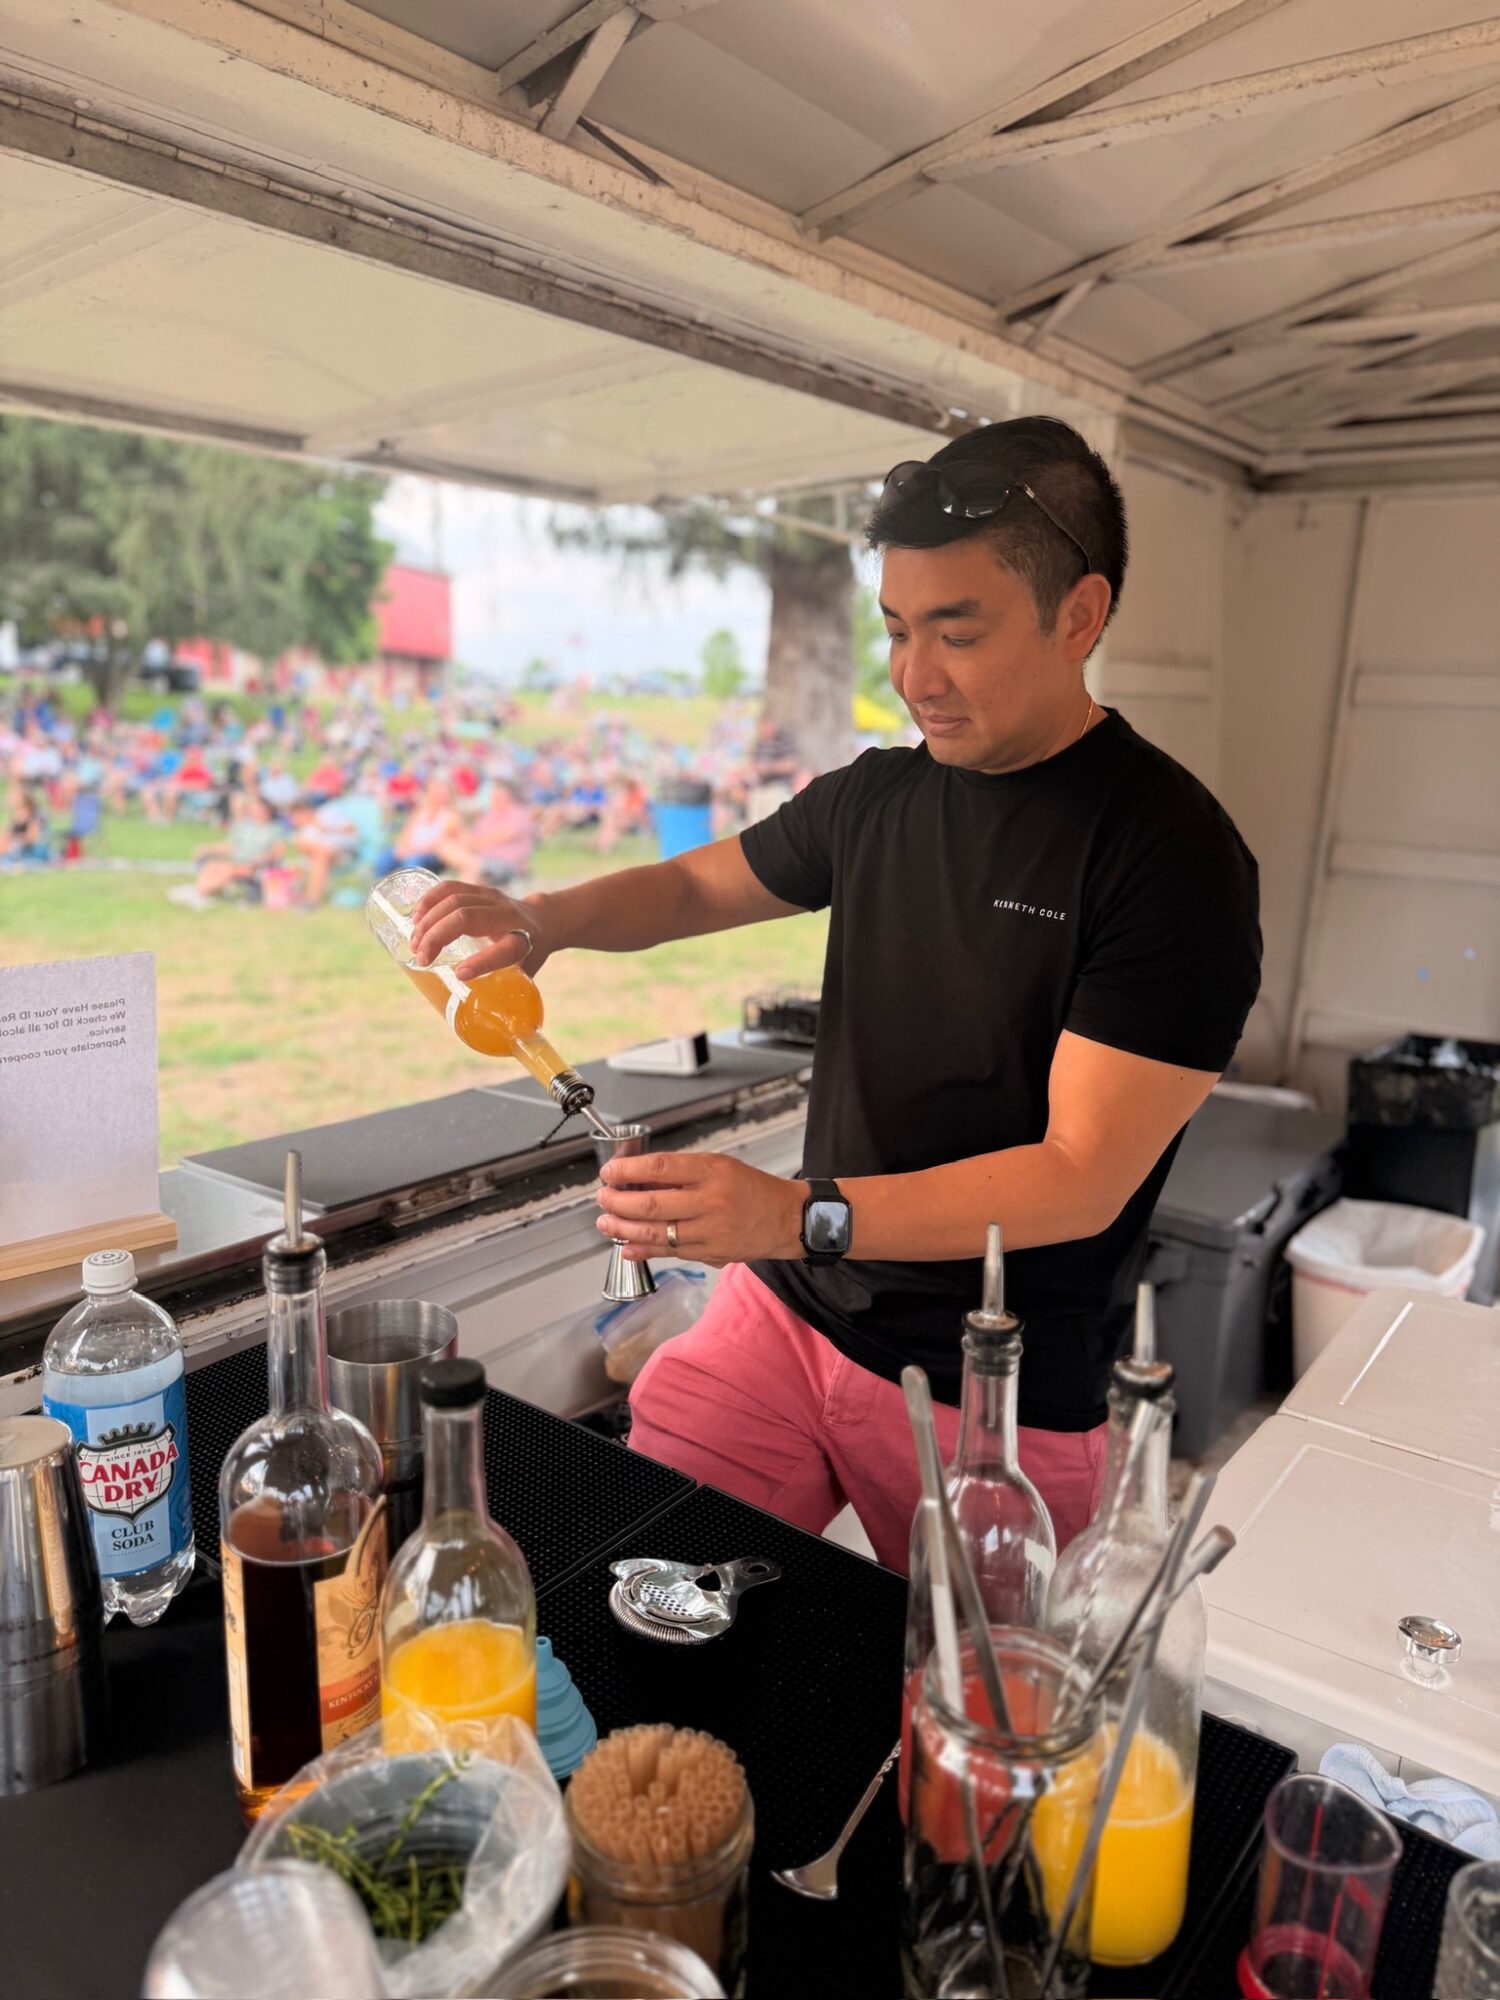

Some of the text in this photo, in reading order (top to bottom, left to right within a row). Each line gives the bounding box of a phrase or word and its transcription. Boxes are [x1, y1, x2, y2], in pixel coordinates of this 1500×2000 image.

[993, 899, 1066, 920] KENNETH COLE
[80, 1442, 178, 1484] CANADA
[106, 1452, 130, 1462] SINCE
[104, 1472, 158, 1503] DRY
[111, 1520, 154, 1539] CLUB
[112, 1533, 154, 1551] SODA
